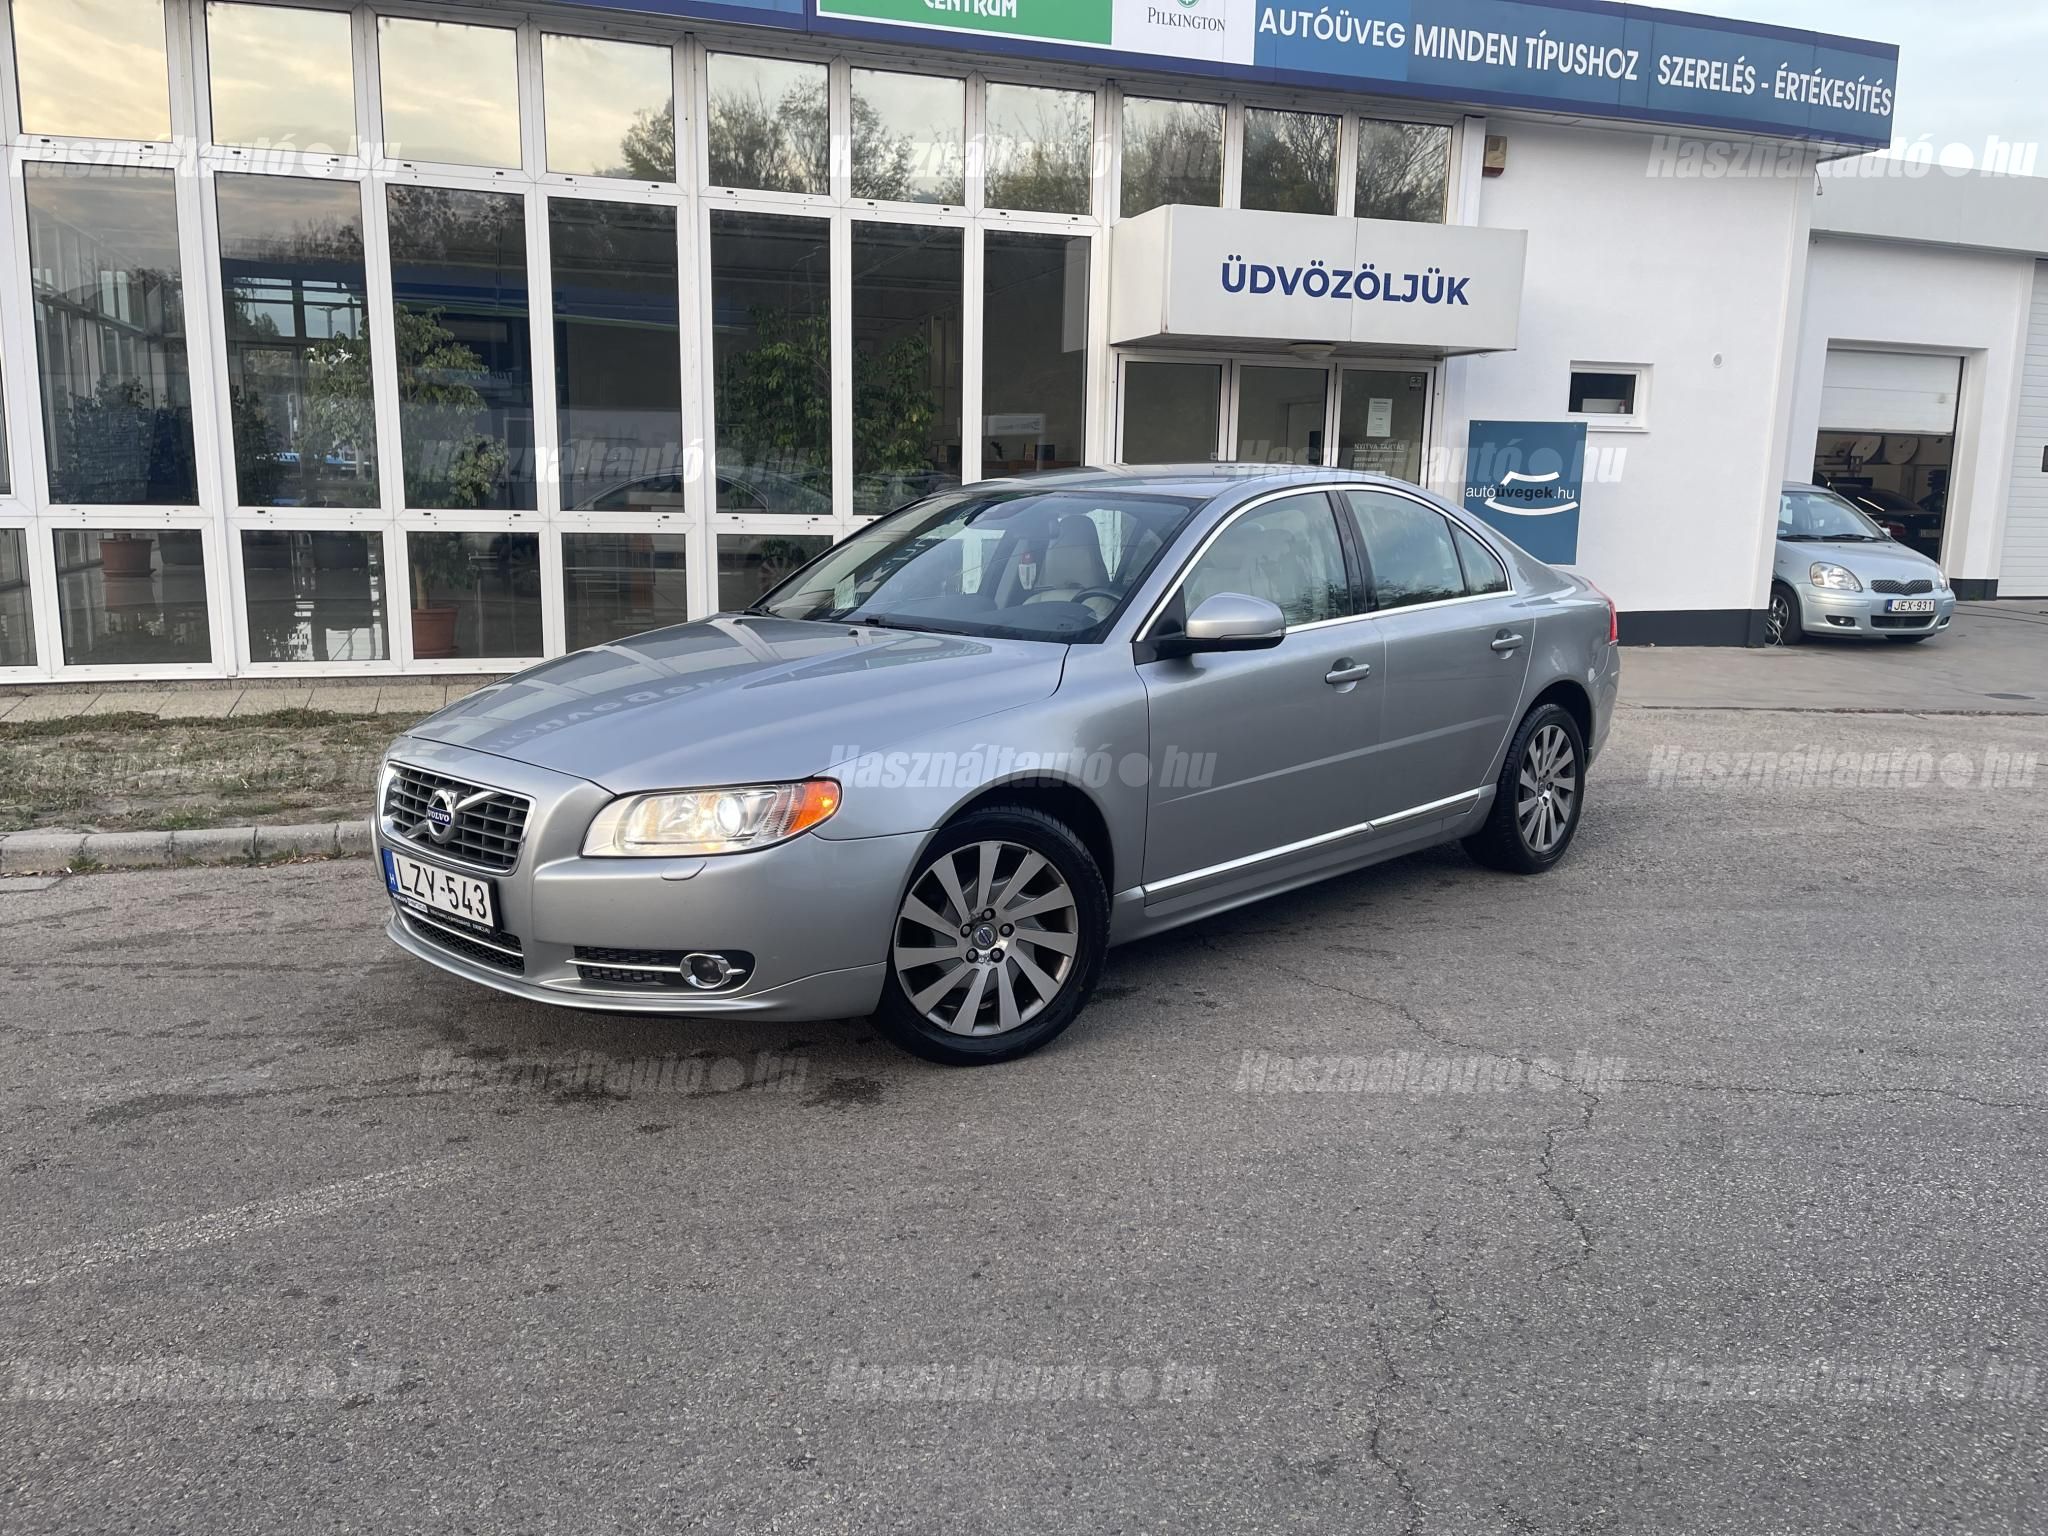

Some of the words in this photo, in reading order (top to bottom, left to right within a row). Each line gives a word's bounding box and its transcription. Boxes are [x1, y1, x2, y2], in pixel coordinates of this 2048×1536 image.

[1147, 7, 1226, 31] PILKINGTON
[1259, 6, 1406, 48] AUTÓÜVEG
[1414, 24, 1518, 67] MINDEN
[1525, 29, 1639, 81] TÍPUSHOZ
[1657, 54, 1756, 95] SZERELÉS
[1774, 61, 1892, 116] ÉRTÉKESÍTÉS
[1222, 254, 1470, 305] ÜDVÖZÖLJÜK
[1466, 483, 1575, 501] autóüvegek.hu
[1894, 600, 1932, 611] JEX-931
[427, 809, 450, 822] VOLVO
[396, 858, 487, 919] LZY-543
